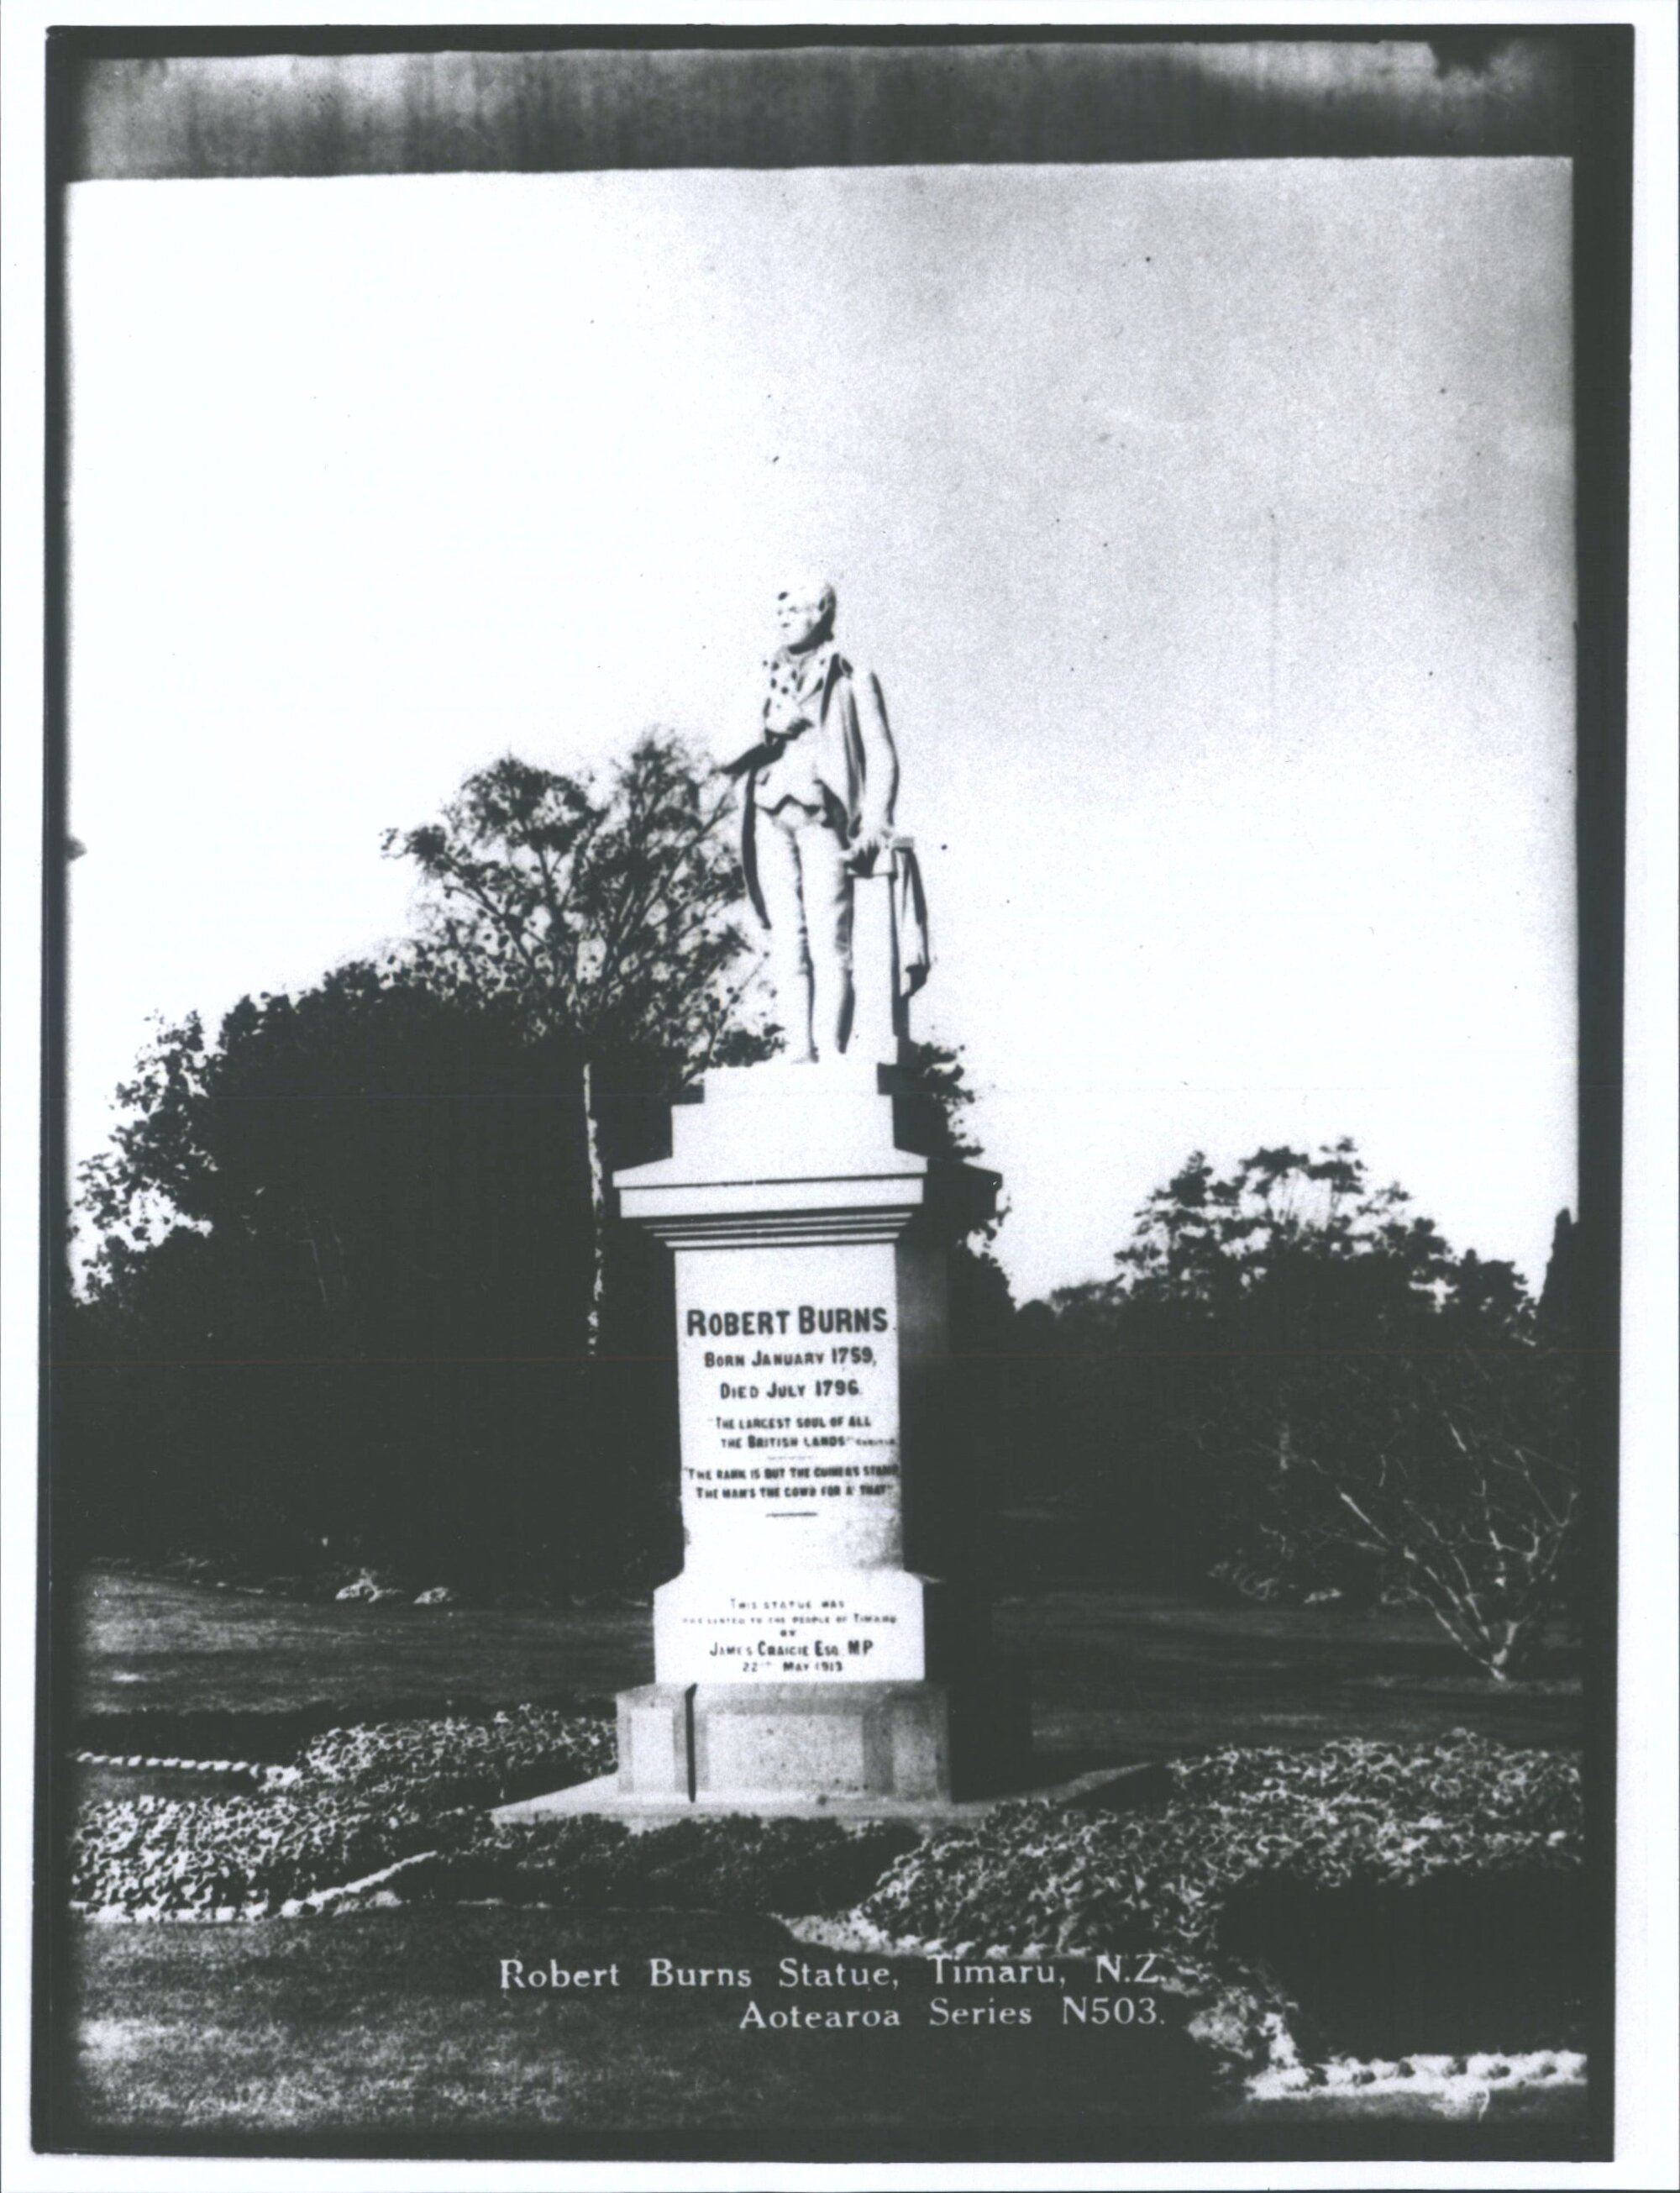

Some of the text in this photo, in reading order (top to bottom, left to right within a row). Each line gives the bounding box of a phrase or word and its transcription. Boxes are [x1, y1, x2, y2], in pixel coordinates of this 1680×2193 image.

[686, 1308, 790, 1338] ROBERT
[704, 1345, 877, 1369] BORN JANUARY 1759,
[720, 1382, 759, 1400] DIED
[766, 1381, 806, 1399] JULY
[795, 1417, 827, 1428] SOUL
[829, 1416, 844, 1428] OF
[848, 1415, 872, 1428] ALL
[721, 1438, 742, 1449] THE
[747, 1434, 799, 1449] BRITISH
[750, 1469, 761, 1480] IS
[789, 1467, 811, 1479] THE
[696, 1486, 718, 1499] THE
[759, 1486, 780, 1498] THE
[821, 1485, 842, 1497] FOR
[764, 1601, 811, 1609] STATUE
[709, 1642, 753, 1657] JAMES
[782, 1661, 810, 1672] MAY
[815, 1660, 843, 1672] 1913
